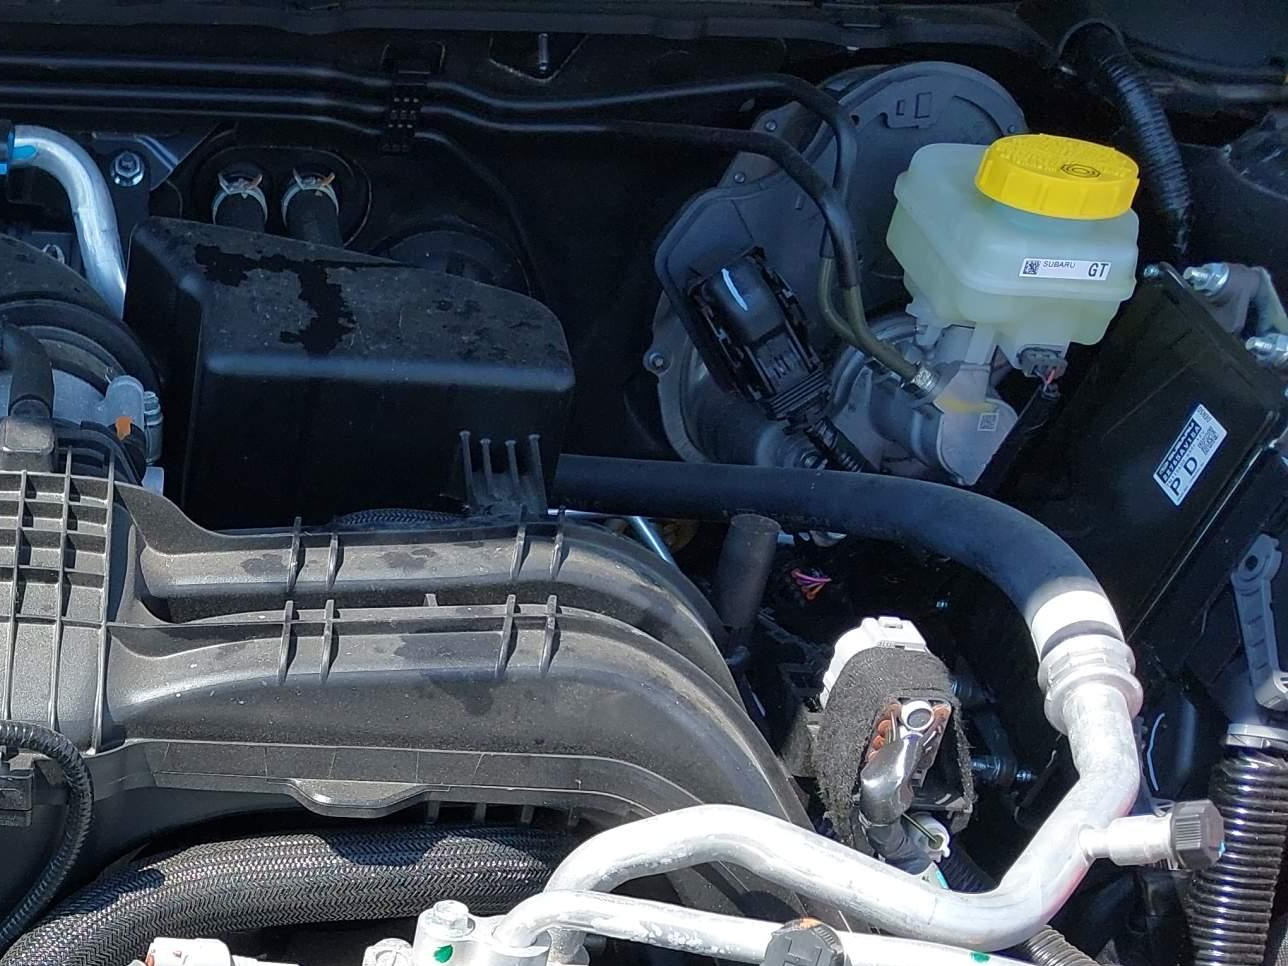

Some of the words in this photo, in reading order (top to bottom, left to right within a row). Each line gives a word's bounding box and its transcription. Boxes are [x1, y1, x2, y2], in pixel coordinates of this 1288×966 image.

[1043, 260, 1076, 269] SUBARU
[1088, 262, 1109, 278] GT
[1170, 477, 1181, 496] P
[1183, 456, 1198, 476] D
